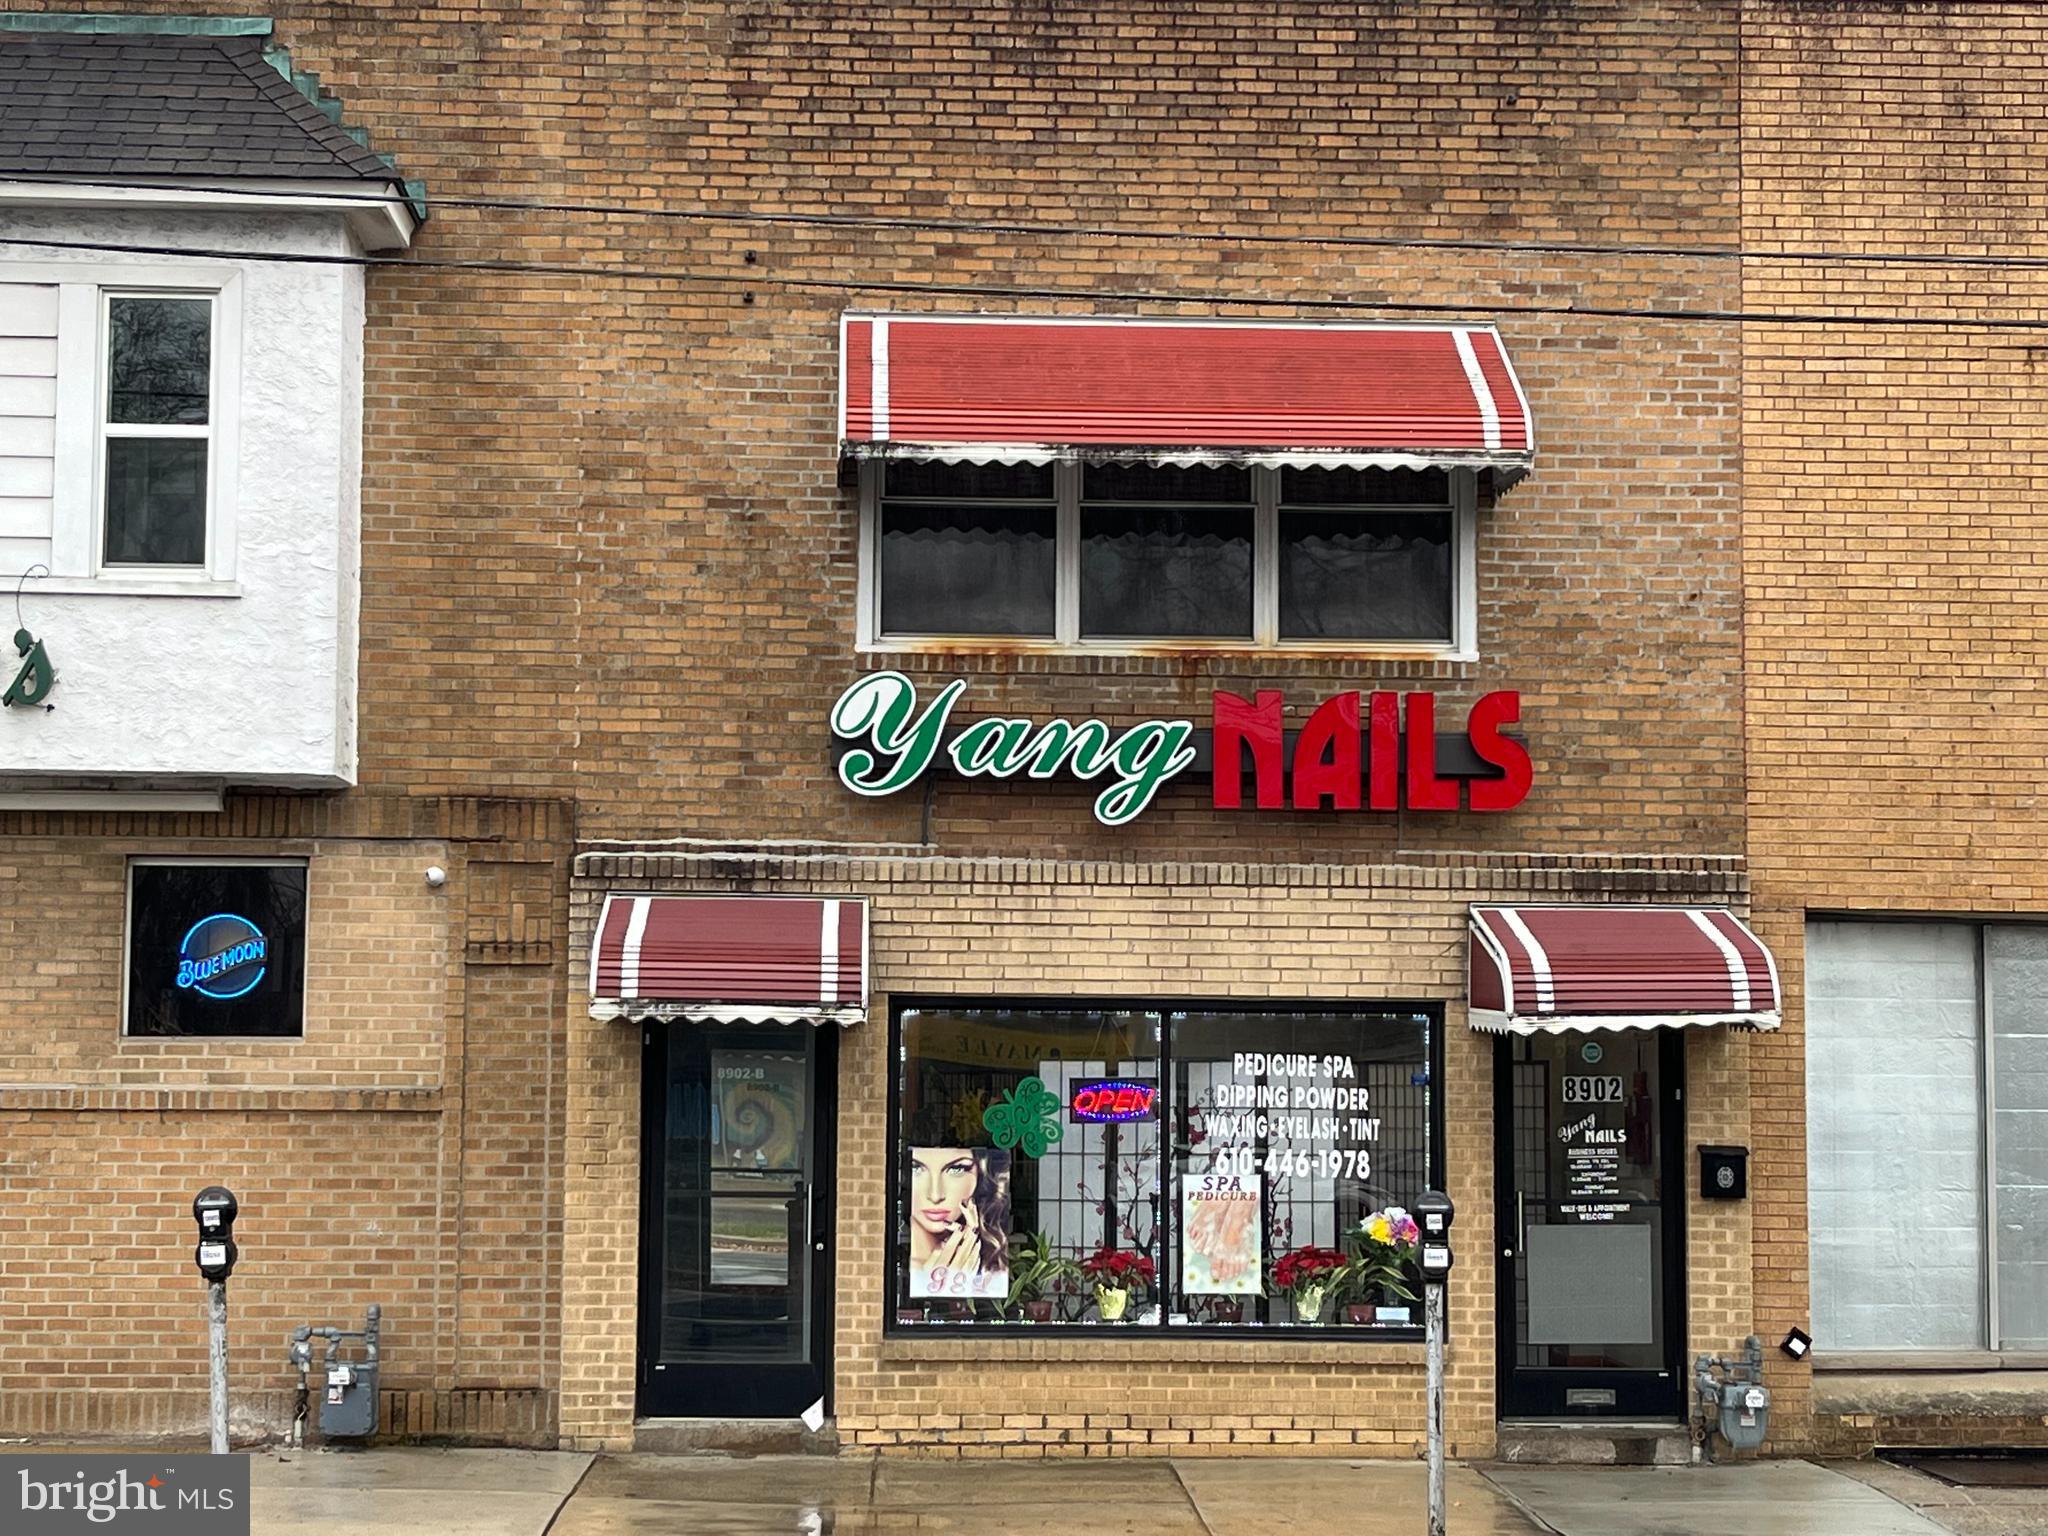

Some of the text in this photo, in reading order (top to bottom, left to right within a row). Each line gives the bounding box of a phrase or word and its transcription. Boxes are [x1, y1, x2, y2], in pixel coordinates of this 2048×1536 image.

[830, 670, 1533, 826] Yang NAILS
[221, 940, 265, 970] MOON
[717, 1067, 765, 1079] 8902-B
[1234, 1053, 1355, 1079] PEDICURE SPA
[1073, 1088, 1156, 1113] OPEN
[1216, 1084, 1369, 1110] DIPPING POWDER
[1565, 1077, 1621, 1101] 8902
[1205, 1114, 1381, 1141] WAXING EYELASH TINT
[1558, 1113, 1627, 1143] Yang NAILS
[1215, 1147, 1370, 1179] 610-446-1978
[1188, 1191, 1257, 1201] PEDICURE
[1201, 1176, 1242, 1191] SPA
